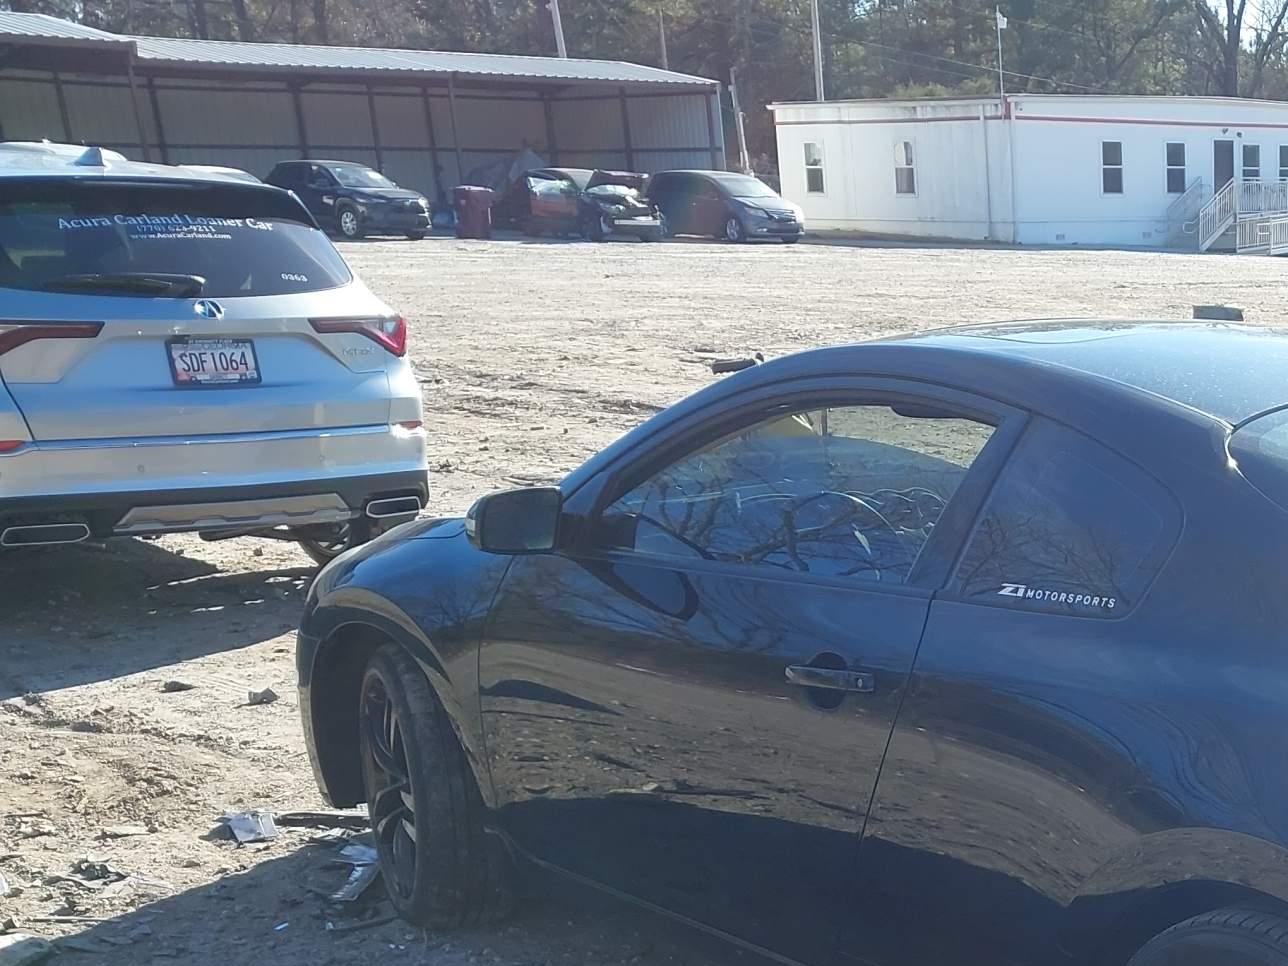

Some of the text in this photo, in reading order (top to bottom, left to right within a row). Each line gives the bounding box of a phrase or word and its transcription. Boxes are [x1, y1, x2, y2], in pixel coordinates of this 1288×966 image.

[59, 213, 274, 231] Acura Carland Loaner Car
[1026, 588, 1116, 608] MOTORSPORTS
